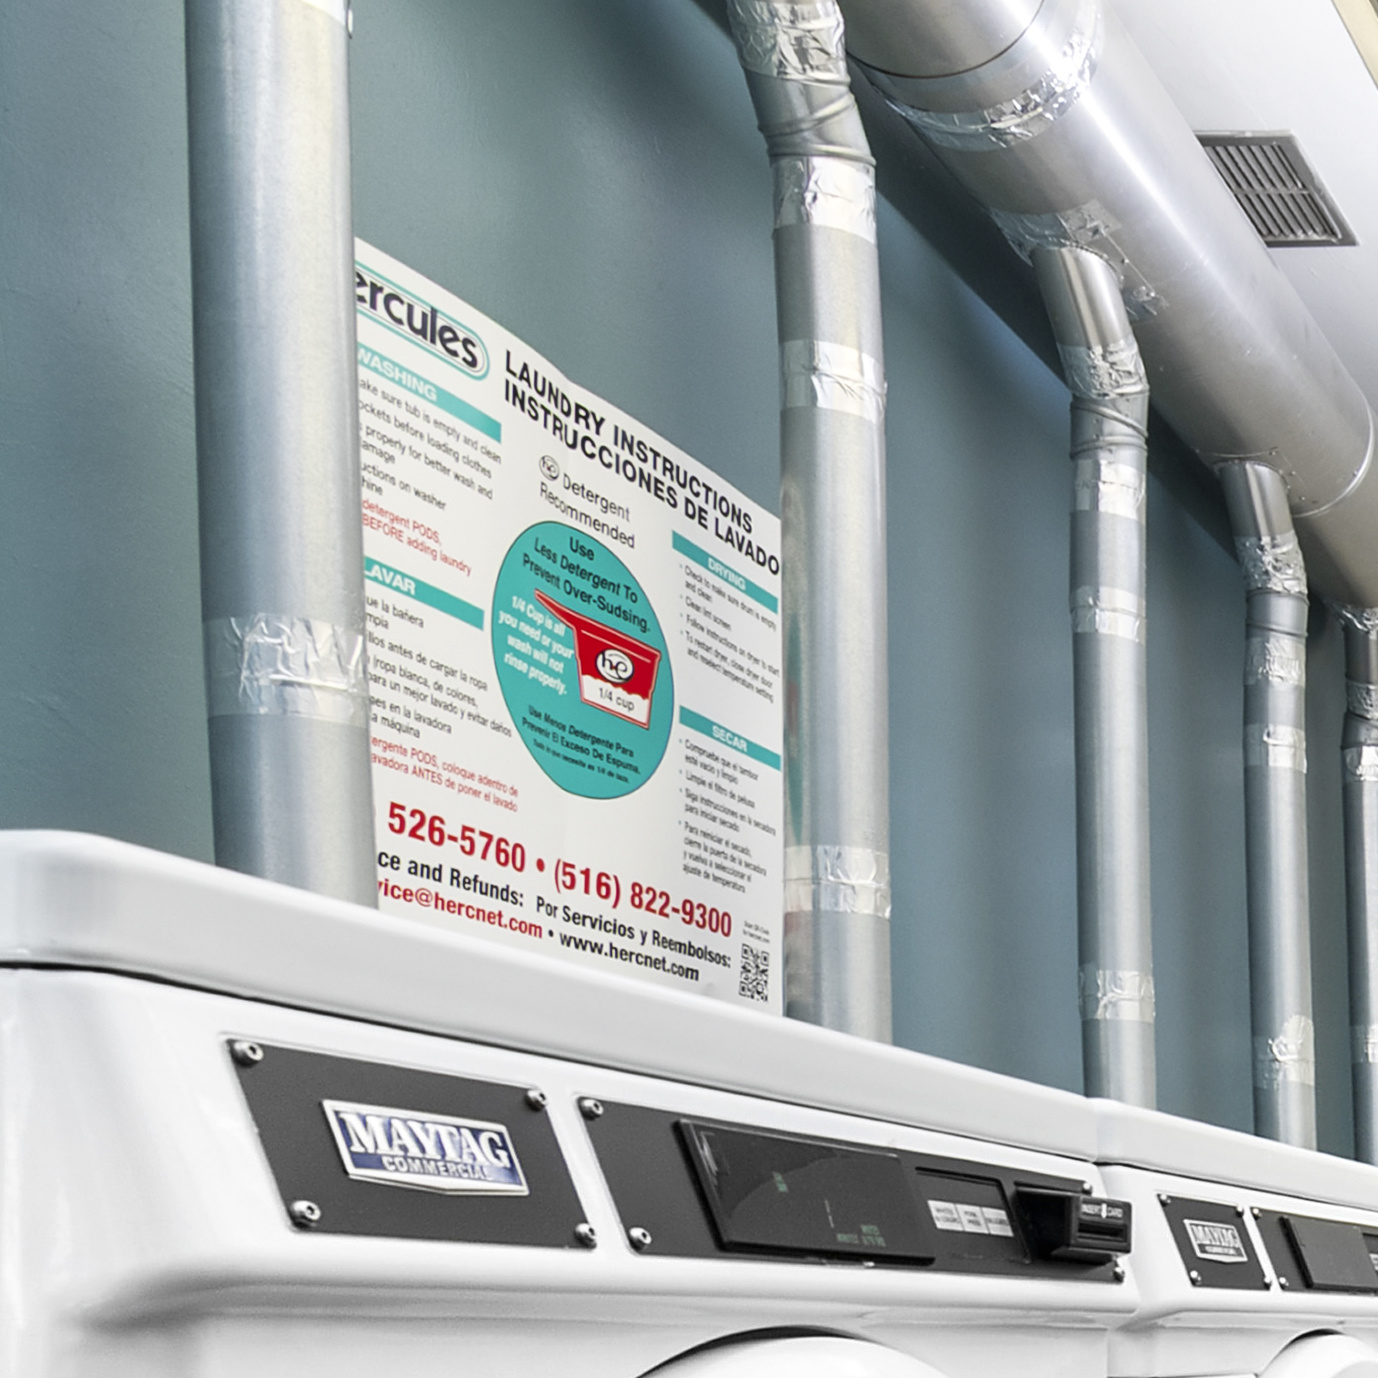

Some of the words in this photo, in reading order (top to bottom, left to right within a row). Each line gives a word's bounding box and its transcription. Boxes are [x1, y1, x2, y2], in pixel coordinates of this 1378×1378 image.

[365, 425, 406, 456] properly
[408, 445, 422, 461] for
[424, 453, 451, 477] better
[453, 471, 476, 490] wash
[477, 484, 493, 500] and
[394, 415, 424, 441] before
[427, 432, 460, 464] loading
[461, 453, 492, 479] clothes
[505, 350, 606, 436] LAUNDRY
[613, 424, 753, 534] INSTRUCTIONS
[504, 378, 678, 510] INSTRUCCIONES
[684, 497, 708, 531] DE
[714, 516, 780, 576] LAVADO
[562, 473, 631, 522] Detergent
[362, 513, 404, 543] BEFORE
[406, 536, 438, 562] adding
[440, 550, 472, 577] laundry
[540, 481, 636, 549] Recommended
[534, 537, 558, 564] Less
[560, 555, 621, 597] Detergent
[623, 585, 639, 604] To
[570, 536, 595, 561] Use
[707, 557, 746, 590] DRYING
[522, 553, 561, 590] Prevent
[563, 579, 651, 634] Over-Sudsing.
[599, 687, 613, 703] 1/4
[615, 695, 635, 713] cup
[521, 716, 552, 740] Prevenir
[552, 731, 560, 743] El
[560, 735, 591, 757] Exceso
[592, 748, 604, 761] De
[528, 704, 542, 720] Use
[543, 712, 567, 732] Menos
[568, 724, 615, 751] Detergente
[615, 741, 635, 758] Para
[712, 725, 748, 752] SECAR
[388, 801, 526, 873] 526-5760
[555, 858, 621, 909] (516)
[630, 881, 733, 938] 822-9300
[408, 859, 443, 883] and
[450, 867, 524, 907] Refunds:
[536, 896, 558, 918] Por
[562, 904, 635, 940] Servicios
[640, 928, 648, 946] y
[652, 929, 732, 968] Reembolsos:
[559, 931, 699, 981] www.hercnet.com
[338, 1112, 511, 1169] MAYTAG
[381, 1156, 493, 1181] COMMERCIAL
